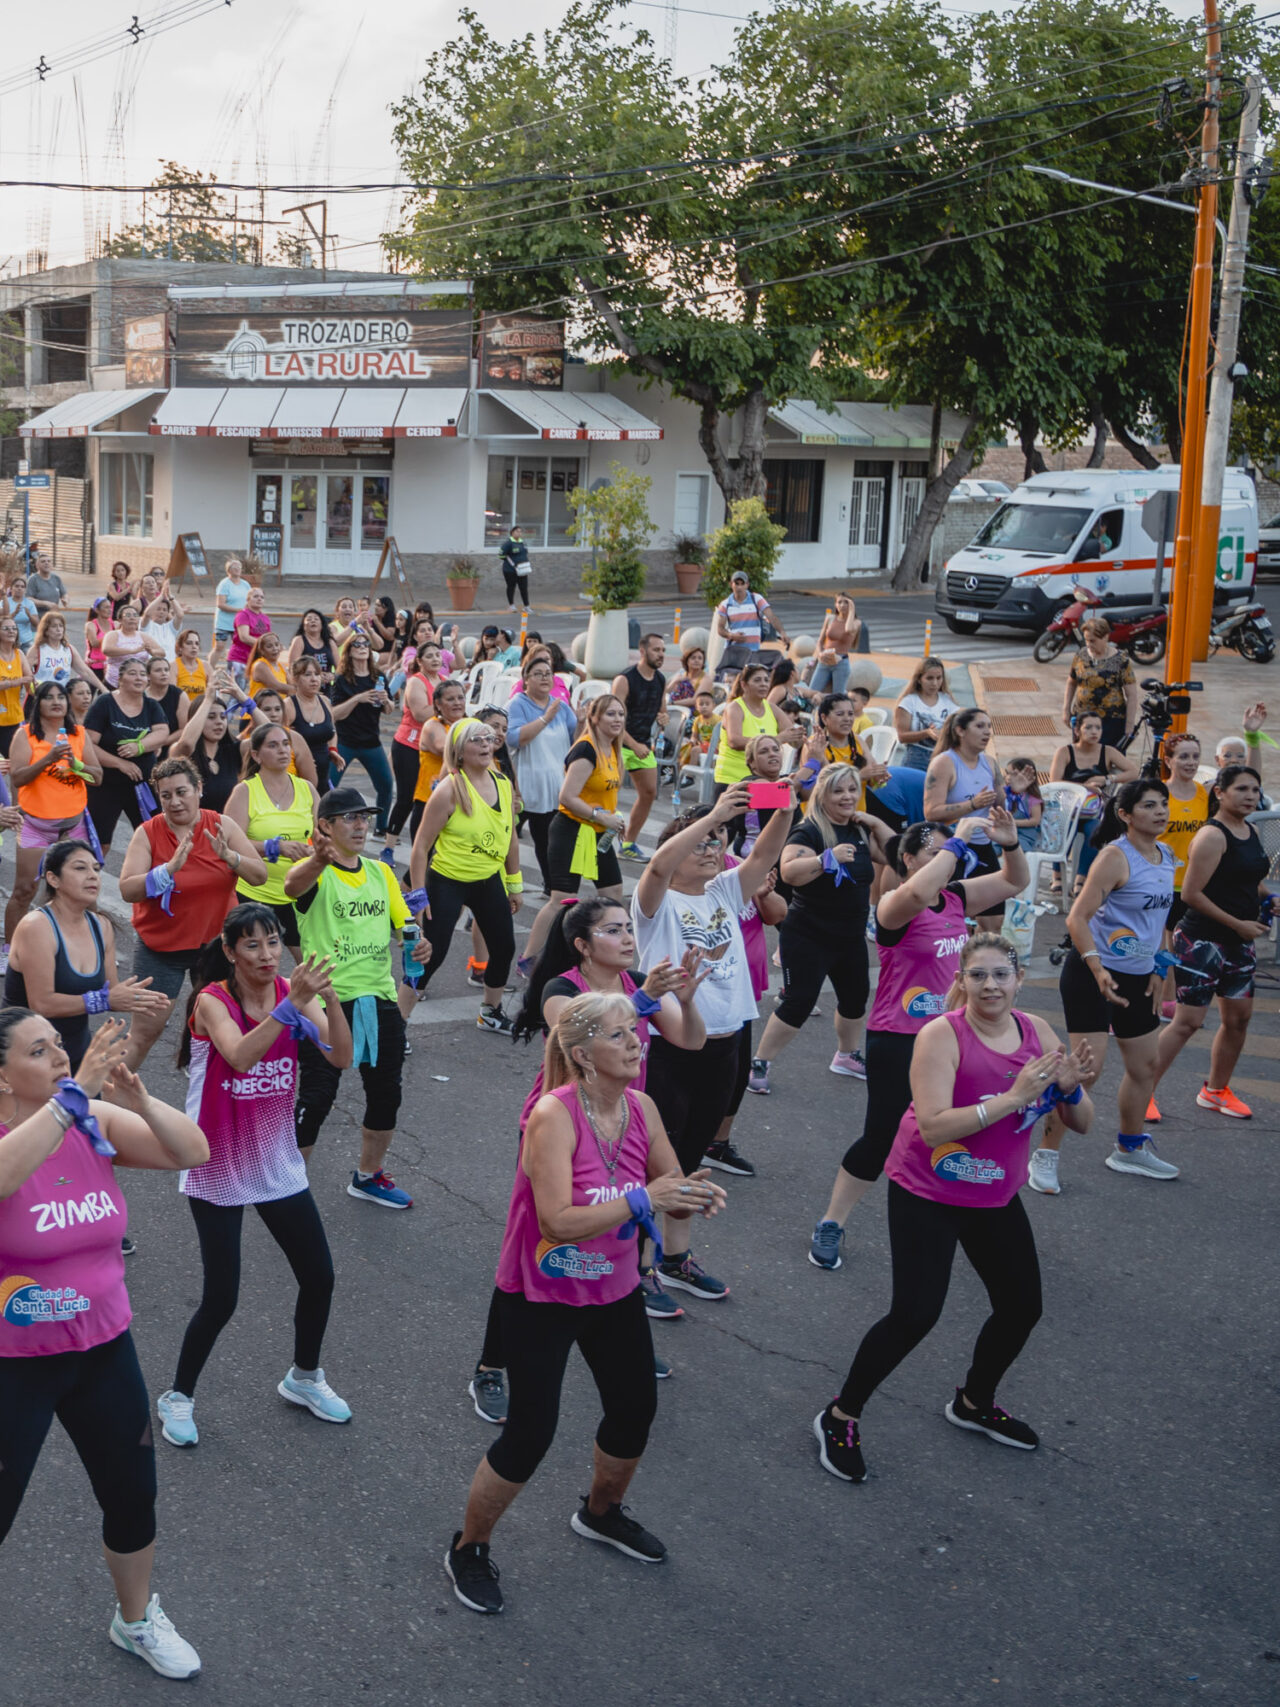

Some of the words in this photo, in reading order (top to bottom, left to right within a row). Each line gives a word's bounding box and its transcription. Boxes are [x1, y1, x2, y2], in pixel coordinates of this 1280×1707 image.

[285, 322, 409, 343] TROZADERO
[264, 353, 305, 376] LA
[319, 353, 427, 376] RURAL
[161, 425, 197, 436] CARNES
[216, 426, 261, 437] PESCADOS
[277, 427, 322, 437] MARISCOS
[338, 427, 384, 437] EMBUTIDOS
[406, 427, 442, 437] CERDO
[549, 429, 577, 439] CARNES
[587, 429, 621, 440] PESCADOS
[628, 430, 660, 440] MARISCOS
[348, 899, 386, 917] ZUMBA
[913, 1000, 938, 1012] Santa
[943, 1158, 976, 1177] Santa
[30, 1190, 119, 1232] ZUMBA
[549, 1252, 586, 1270] Santa
[29, 1287, 62, 1300] Ciudad
[64, 1287, 76, 1299] de
[13, 1297, 51, 1314] Santa
[55, 1295, 90, 1312] Lucía
